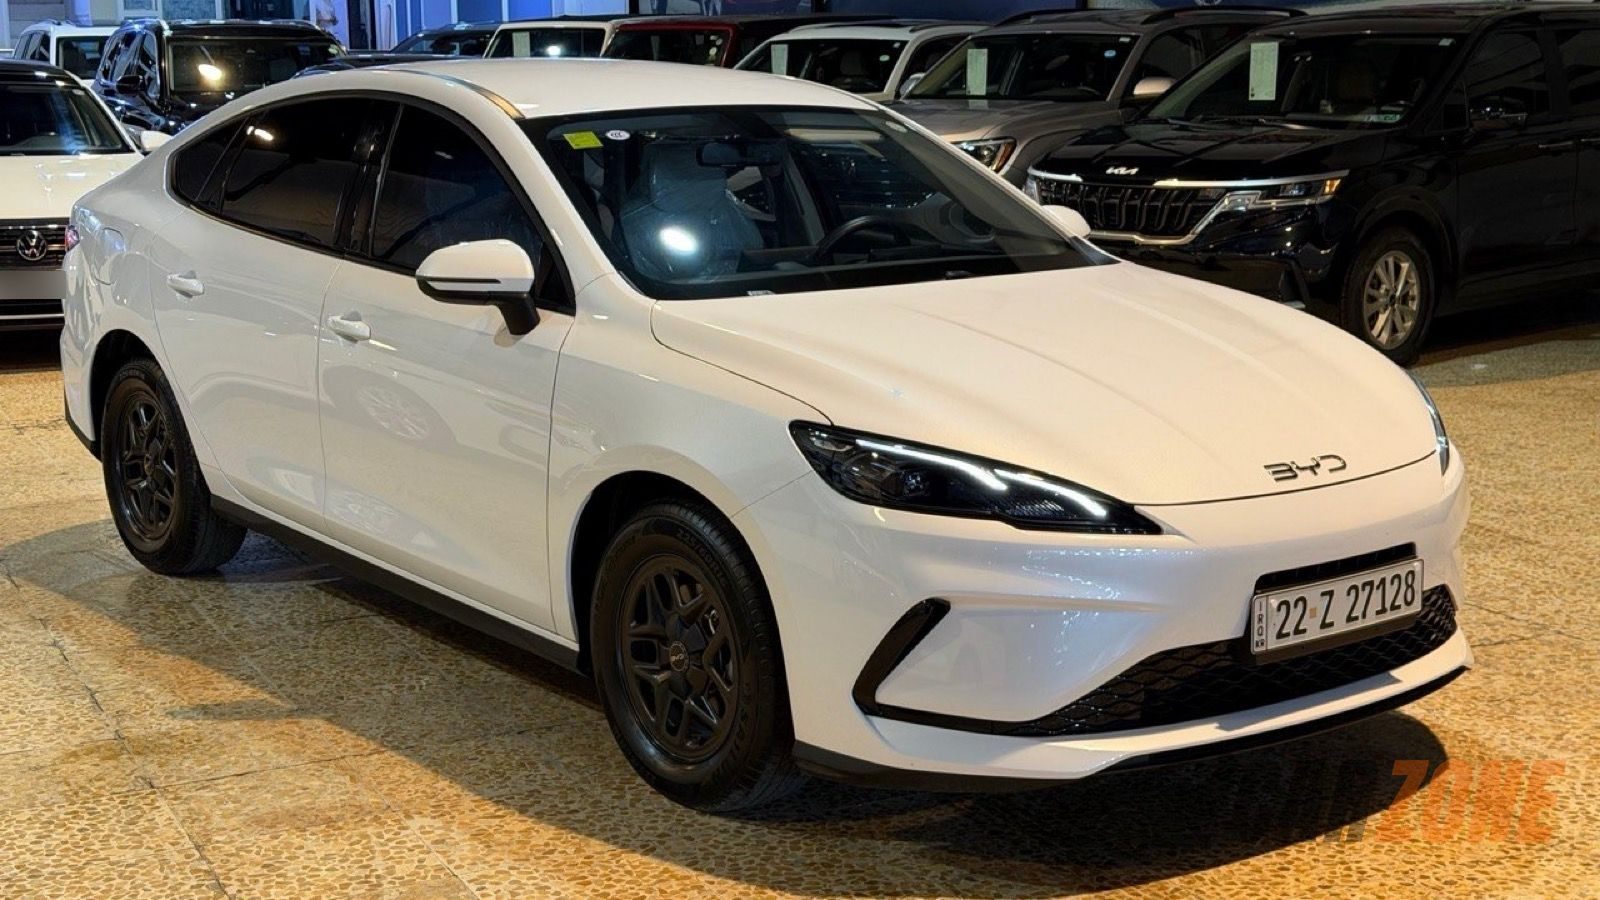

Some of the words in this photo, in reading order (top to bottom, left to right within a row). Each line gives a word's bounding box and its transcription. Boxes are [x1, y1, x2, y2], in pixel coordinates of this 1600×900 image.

[1263, 454, 1347, 482] BYD
[1275, 595, 1308, 640] 22
[1319, 589, 1335, 630] Z
[1345, 569, 1416, 624] 27128
